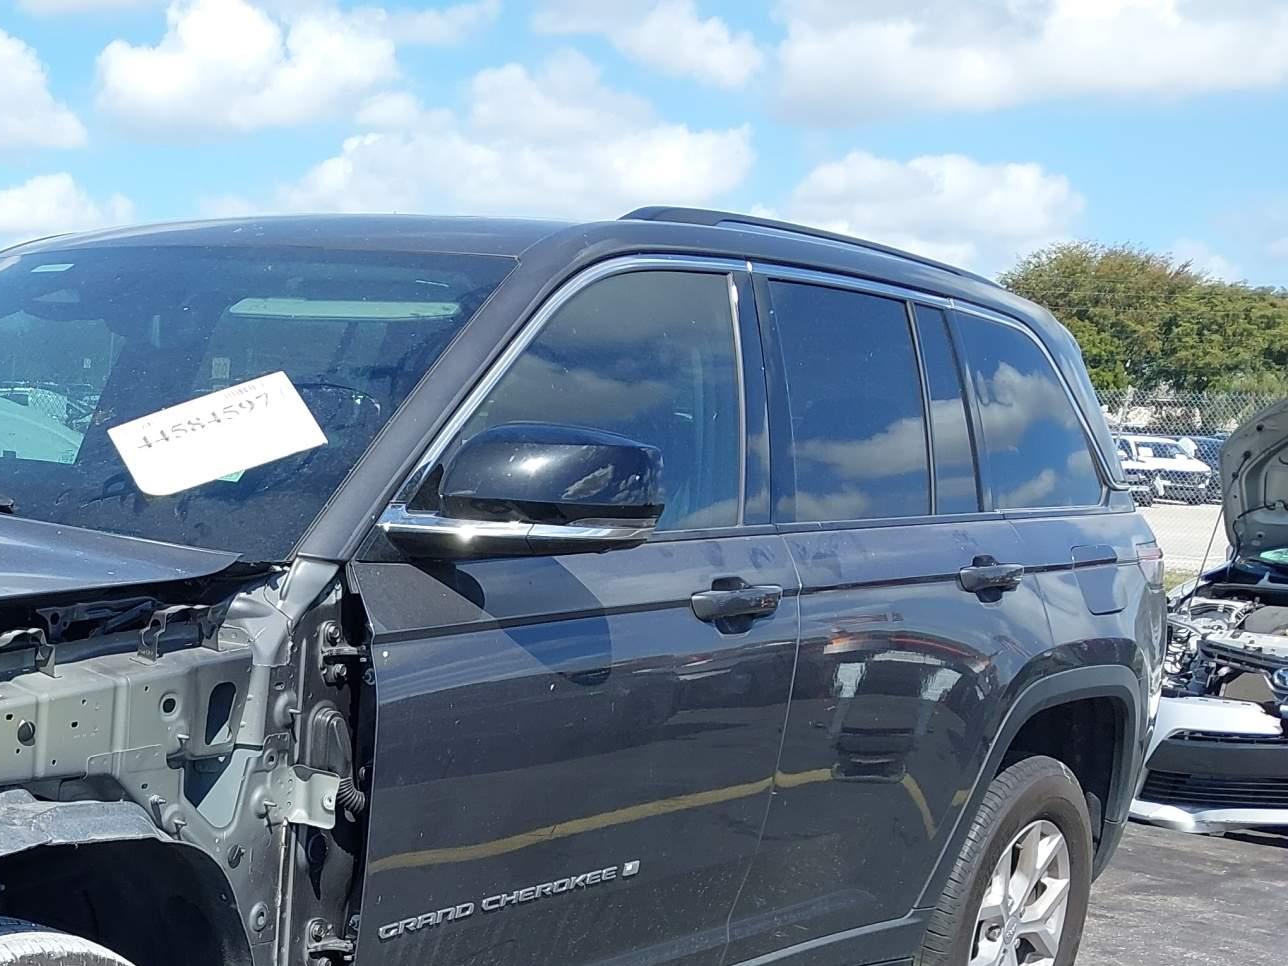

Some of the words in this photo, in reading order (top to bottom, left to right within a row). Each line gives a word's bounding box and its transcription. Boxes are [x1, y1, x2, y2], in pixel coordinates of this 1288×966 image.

[137, 391, 270, 450] 44584597
[377, 902, 476, 940] GRAND
[481, 865, 618, 912] CHEROKEE
